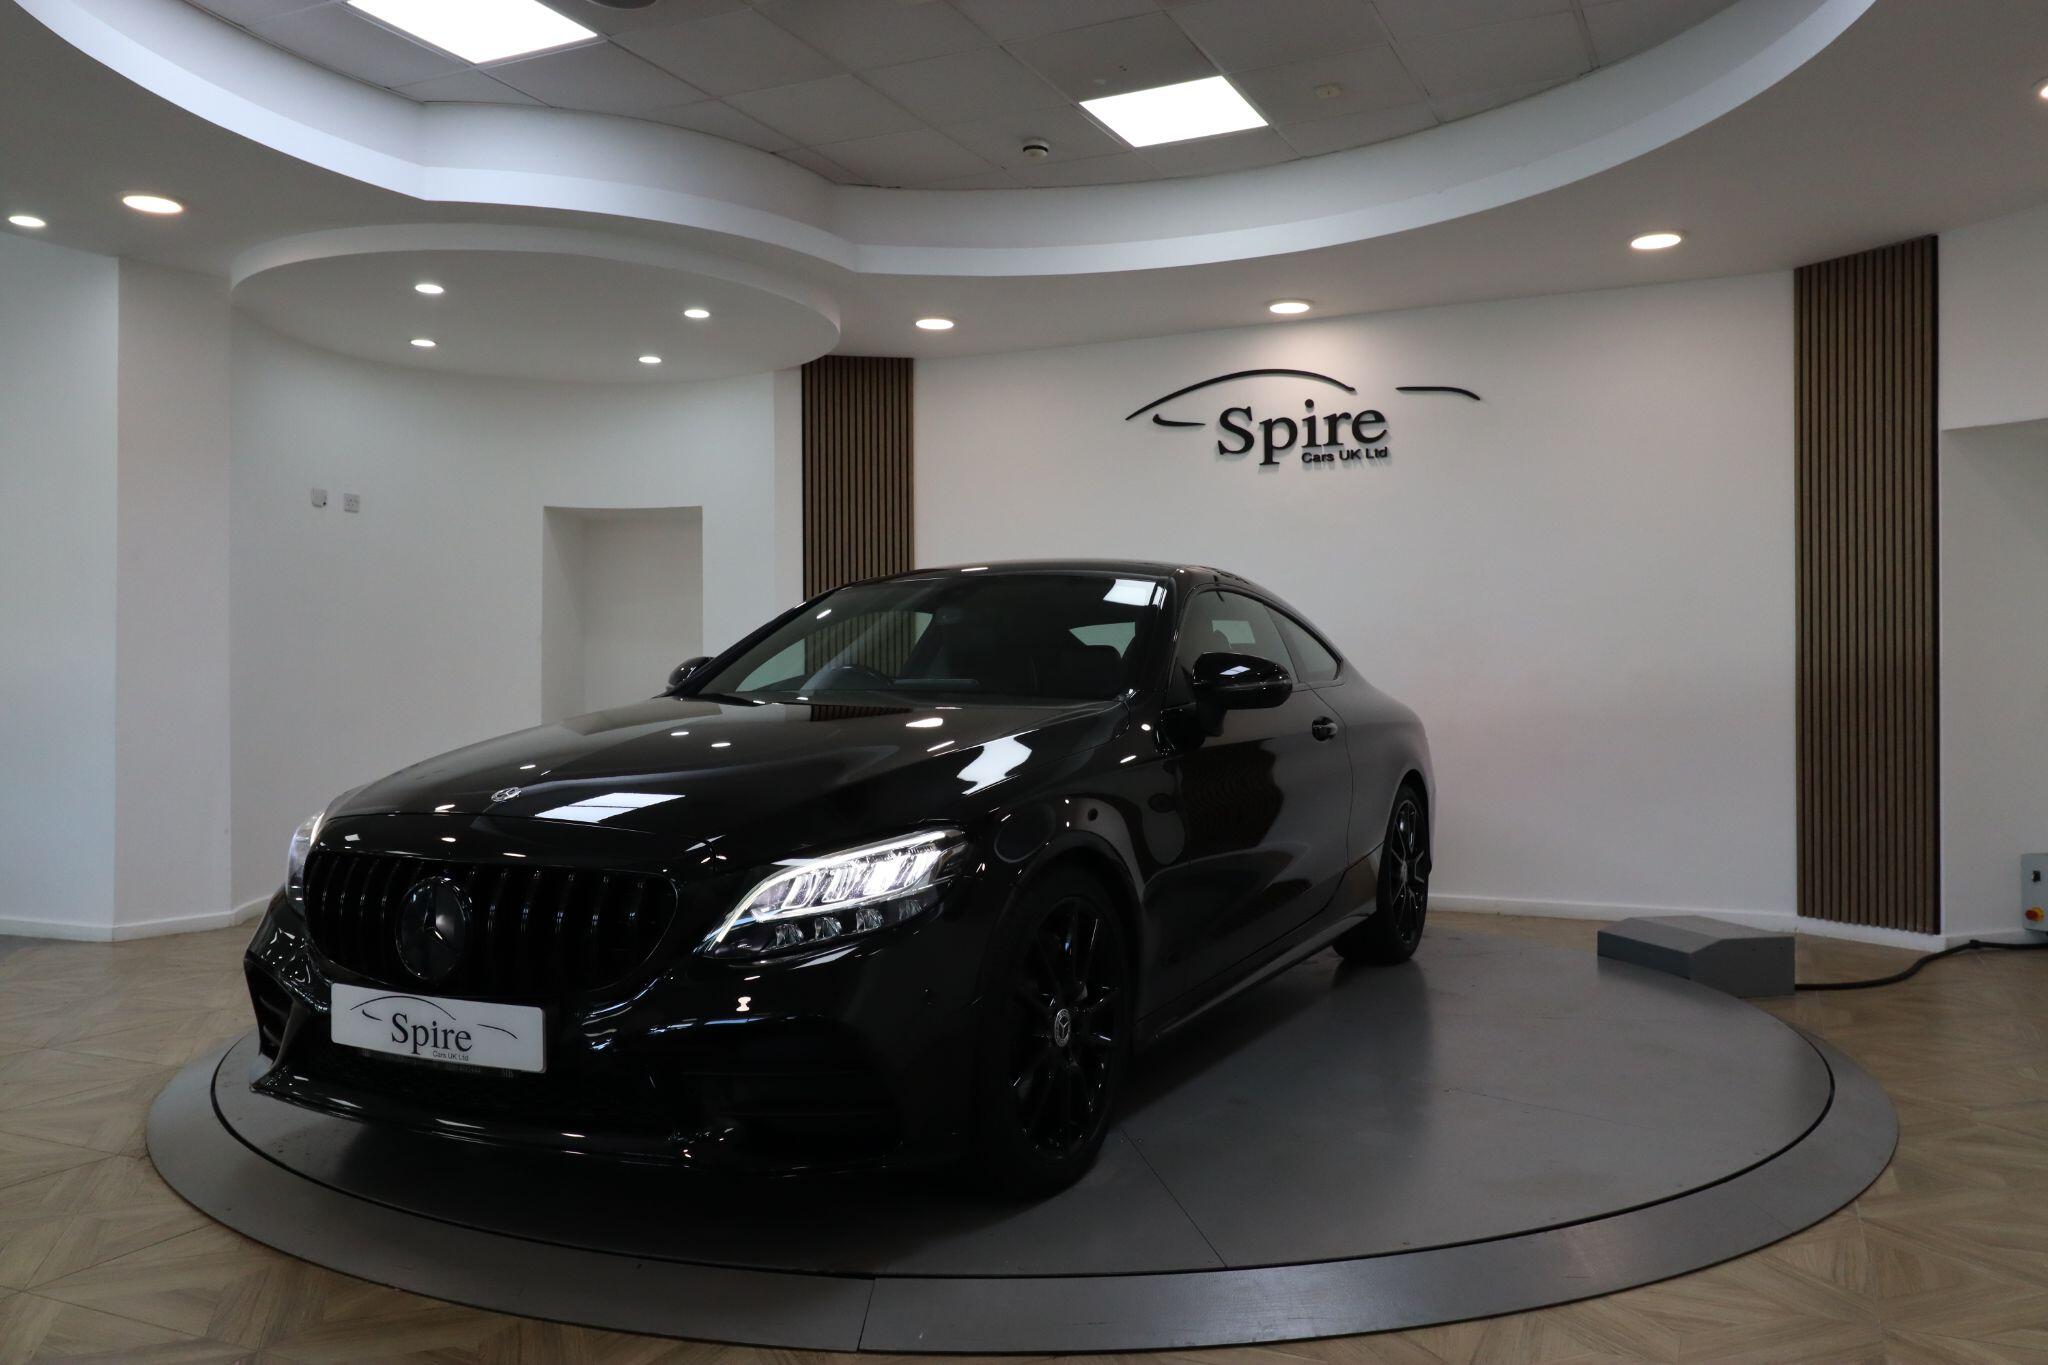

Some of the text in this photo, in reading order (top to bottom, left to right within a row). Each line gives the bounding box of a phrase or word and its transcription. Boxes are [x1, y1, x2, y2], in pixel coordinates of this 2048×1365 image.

[1217, 399, 1388, 465] Spire
[1301, 447, 1388, 464] Cars UK Ltd
[392, 1013, 472, 1055] Spire
[433, 1051, 469, 1061] Cars UK Ltd
